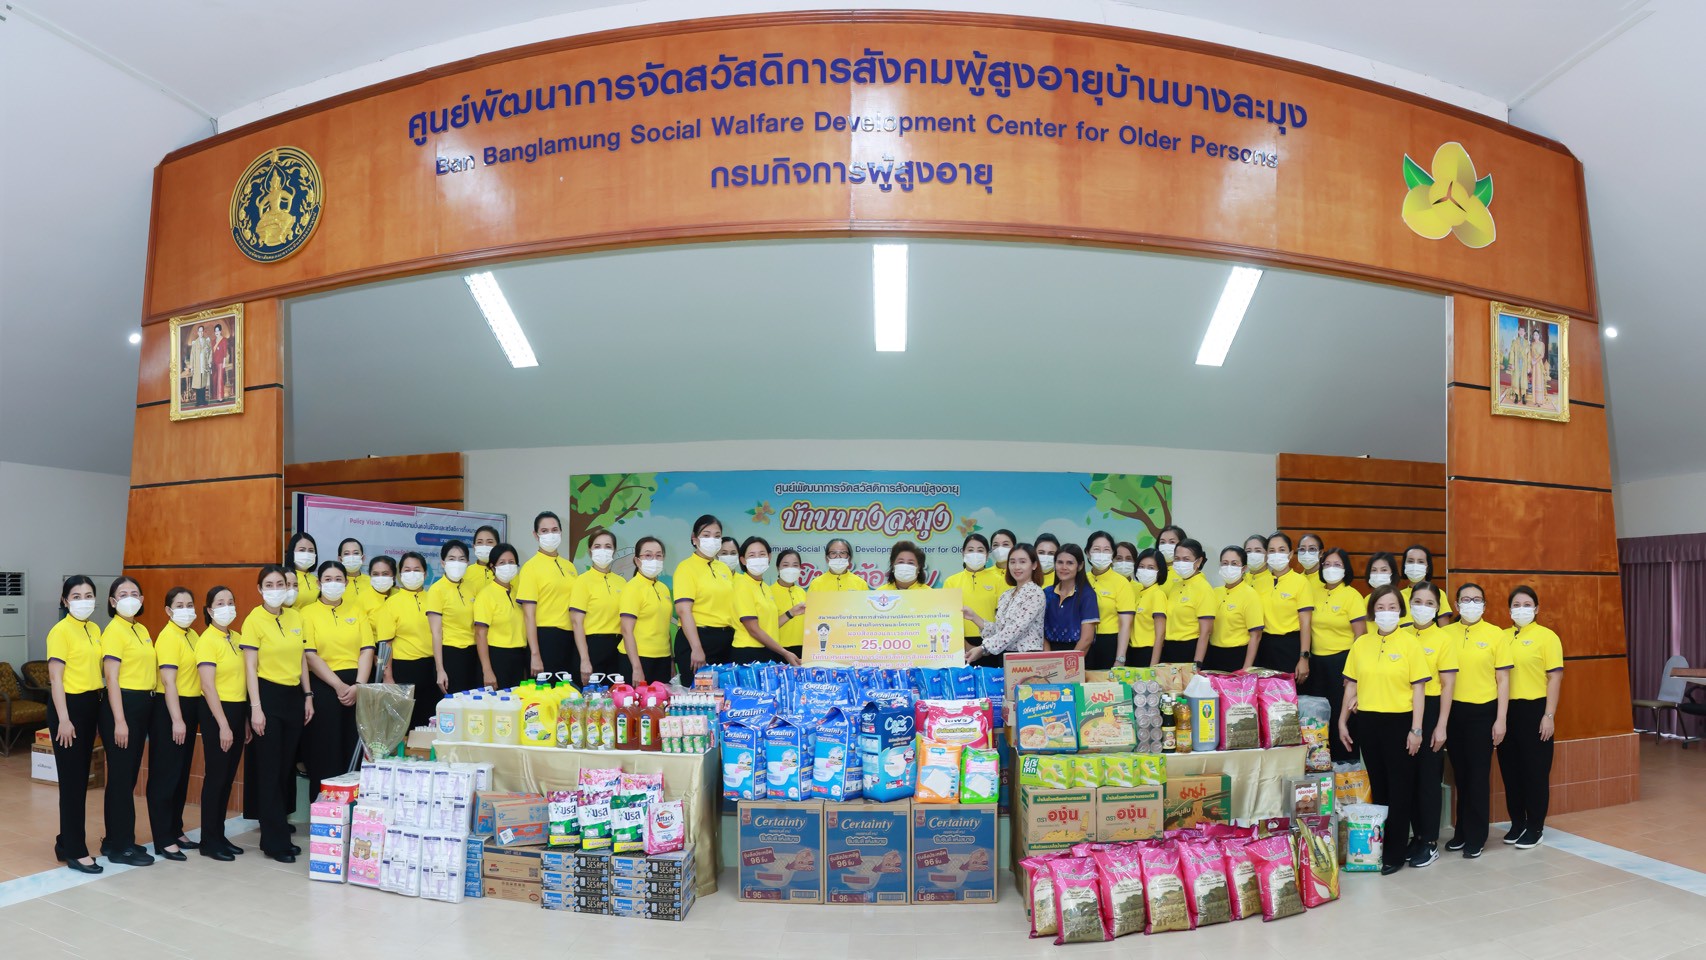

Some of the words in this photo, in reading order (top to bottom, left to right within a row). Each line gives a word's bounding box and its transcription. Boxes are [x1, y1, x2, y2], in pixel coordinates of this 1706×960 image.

[436, 154, 475, 176] Ban
[483, 129, 621, 167] Banglamung
[630, 119, 701, 145] Social
[711, 112, 804, 137] Walfare
[815, 110, 976, 138] Development
[986, 114, 1065, 139] Center
[1076, 121, 1109, 142] for
[1119, 126, 1181, 152] Older
[1191, 134, 1279, 169] Persons
[711, 154, 993, 194] กรมกิจการผู้สูงอายุ
[350, 517, 365, 526] Policy
[782, 501, 952, 541] บ้านบางละมุง
[797, 545, 821, 553] Social
[861, 639, 912, 651] 25,000
[725, 730, 752, 740] Certainty
[766, 729, 796, 738] Certainty
[656, 812, 675, 822] Attack
[1048, 806, 1079, 824] องุ่น
[1117, 804, 1147, 822] องุ่น
[754, 815, 806, 831] Certainty
[841, 818, 893, 832] Certainty
[928, 816, 981, 830] Certainty
[750, 856, 760, 864] 96
[837, 860, 847, 868] 96
[587, 861, 608, 869] SESAME
[659, 866, 681, 874] SESAME
[587, 881, 608, 889] SESAME
[658, 887, 680, 895] SESAME
[587, 900, 608, 908] SESAME
[659, 906, 680, 915] SESAME
